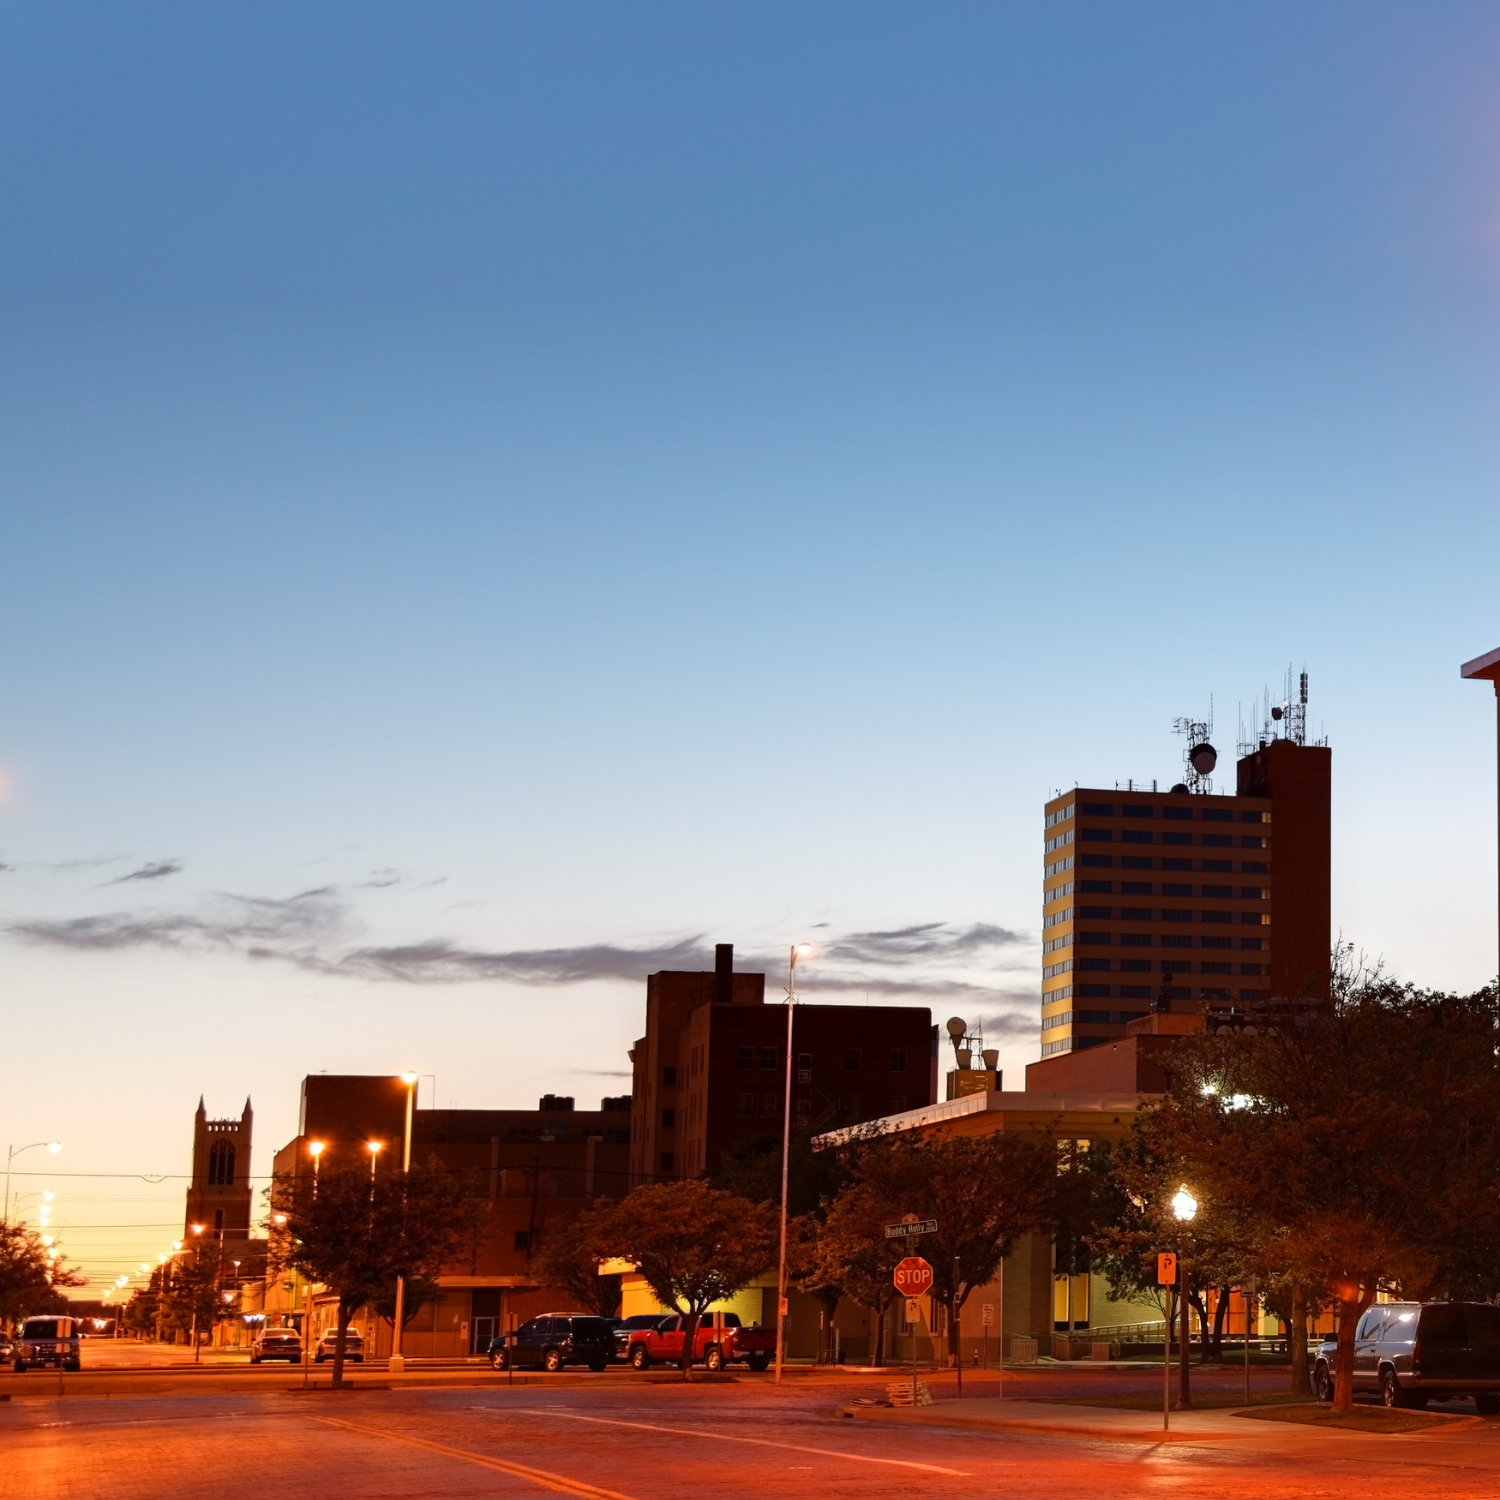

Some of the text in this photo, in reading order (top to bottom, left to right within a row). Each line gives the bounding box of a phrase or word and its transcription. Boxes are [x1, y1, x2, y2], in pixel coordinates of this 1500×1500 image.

[887, 1226, 907, 1236] Buddy
[908, 1223, 925, 1233] Holly
[897, 1269, 930, 1284] STOP
